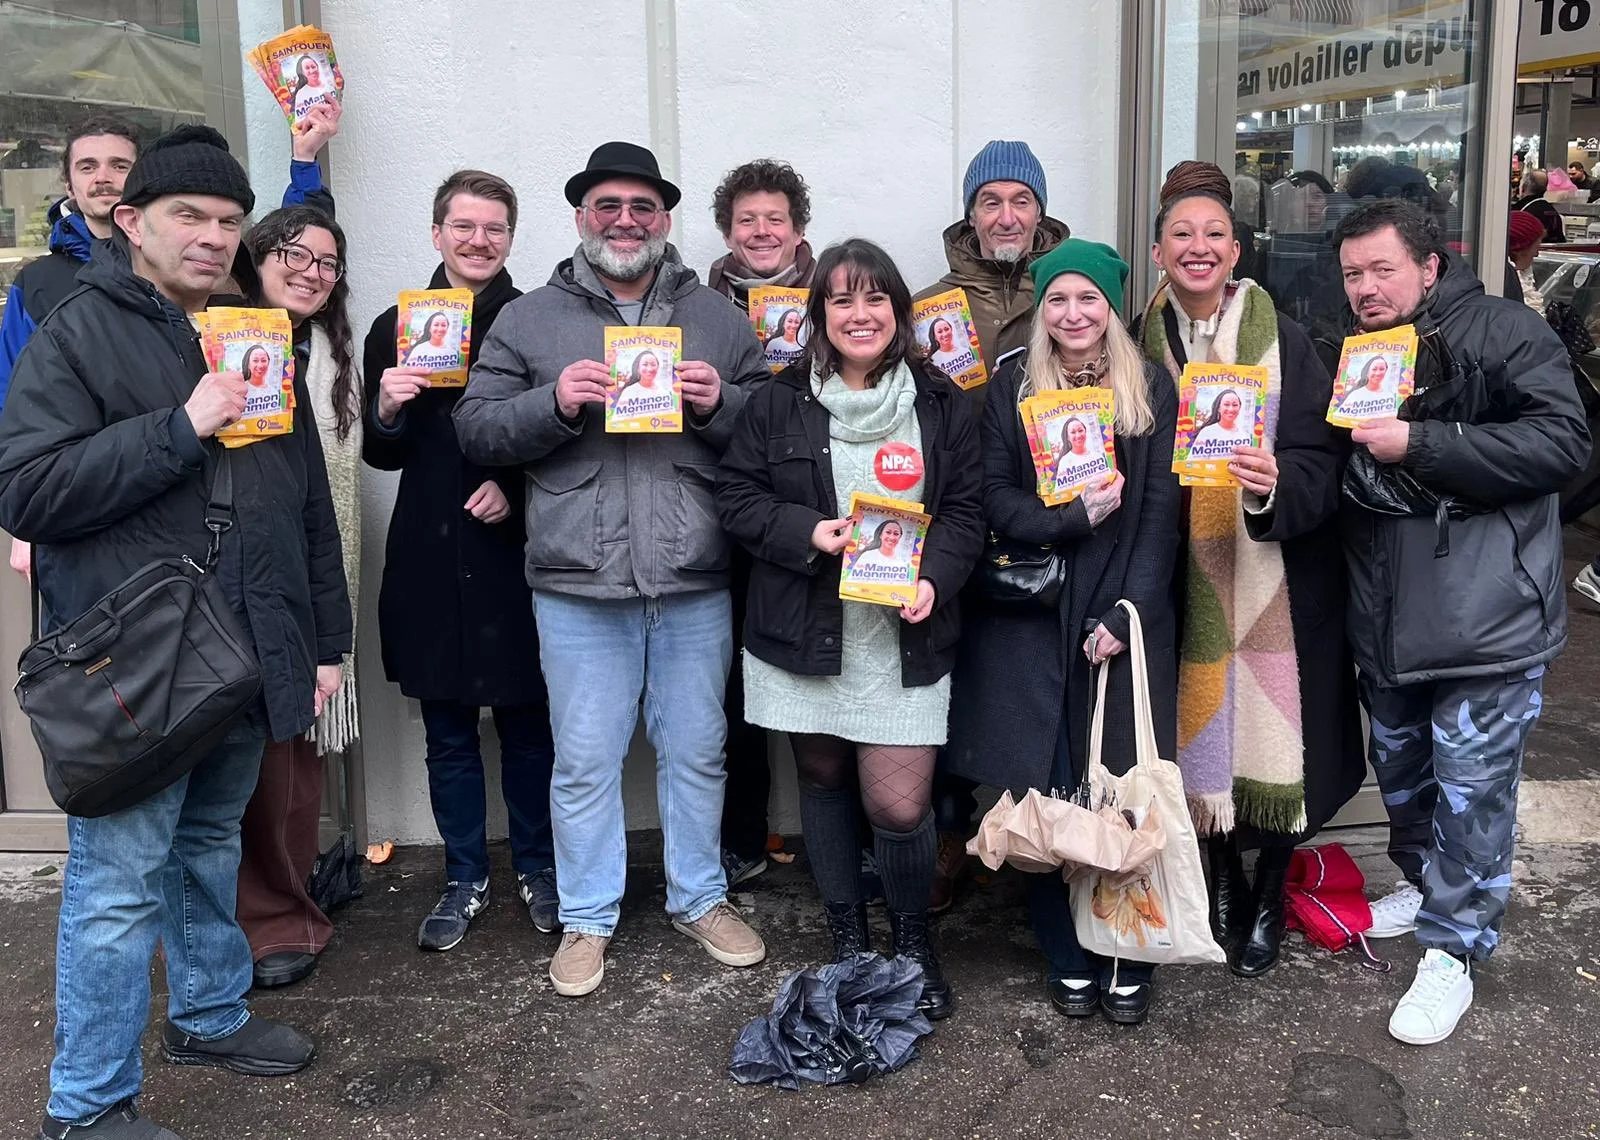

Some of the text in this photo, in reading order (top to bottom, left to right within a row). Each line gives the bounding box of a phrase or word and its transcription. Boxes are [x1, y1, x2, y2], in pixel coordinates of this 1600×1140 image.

[1535, 0, 1591, 35] 18
[1267, 40, 1374, 92] volailler
[304, 91, 336, 106] Mann
[417, 354, 457, 363] Manon
[244, 393, 280, 405] anon
[628, 394, 670, 406] Manon
[1352, 397, 1394, 408] Manon
[1205, 438, 1250, 448] Manon
[882, 455, 915, 470] NPA
[1066, 456, 1104, 476] Manon
[865, 563, 907, 572] Manon
